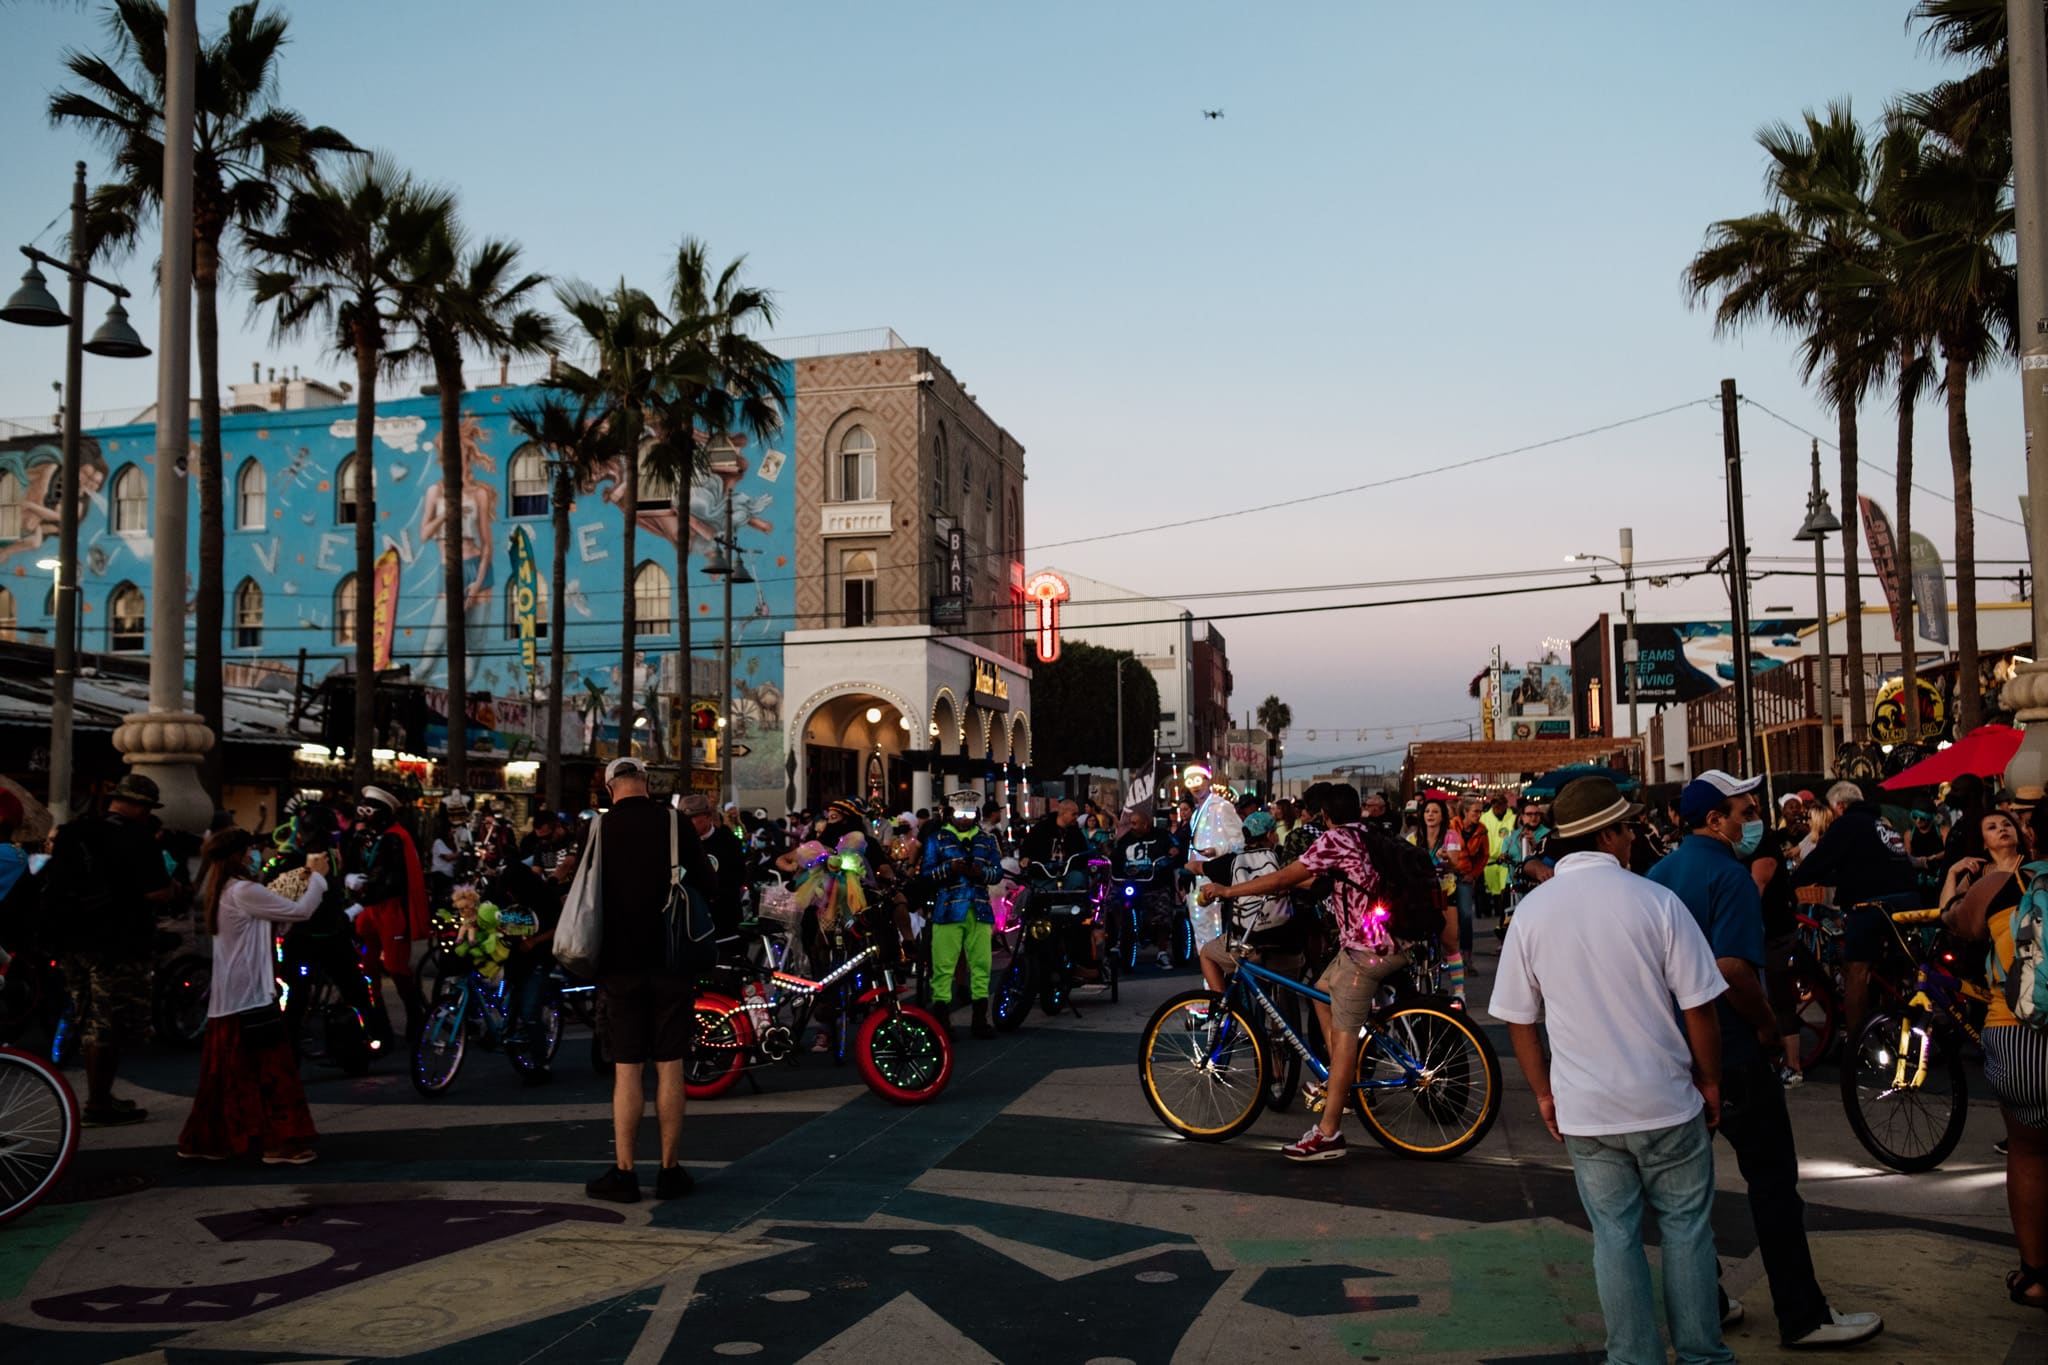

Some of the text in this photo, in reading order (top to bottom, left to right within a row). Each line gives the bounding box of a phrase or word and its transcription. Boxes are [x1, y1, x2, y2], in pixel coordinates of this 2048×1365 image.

[252, 521, 610, 574] VENE
[951, 533, 961, 592] BAR
[1490, 646, 1500, 718] CRYPTO
[1624, 674, 1676, 688] DIVING
